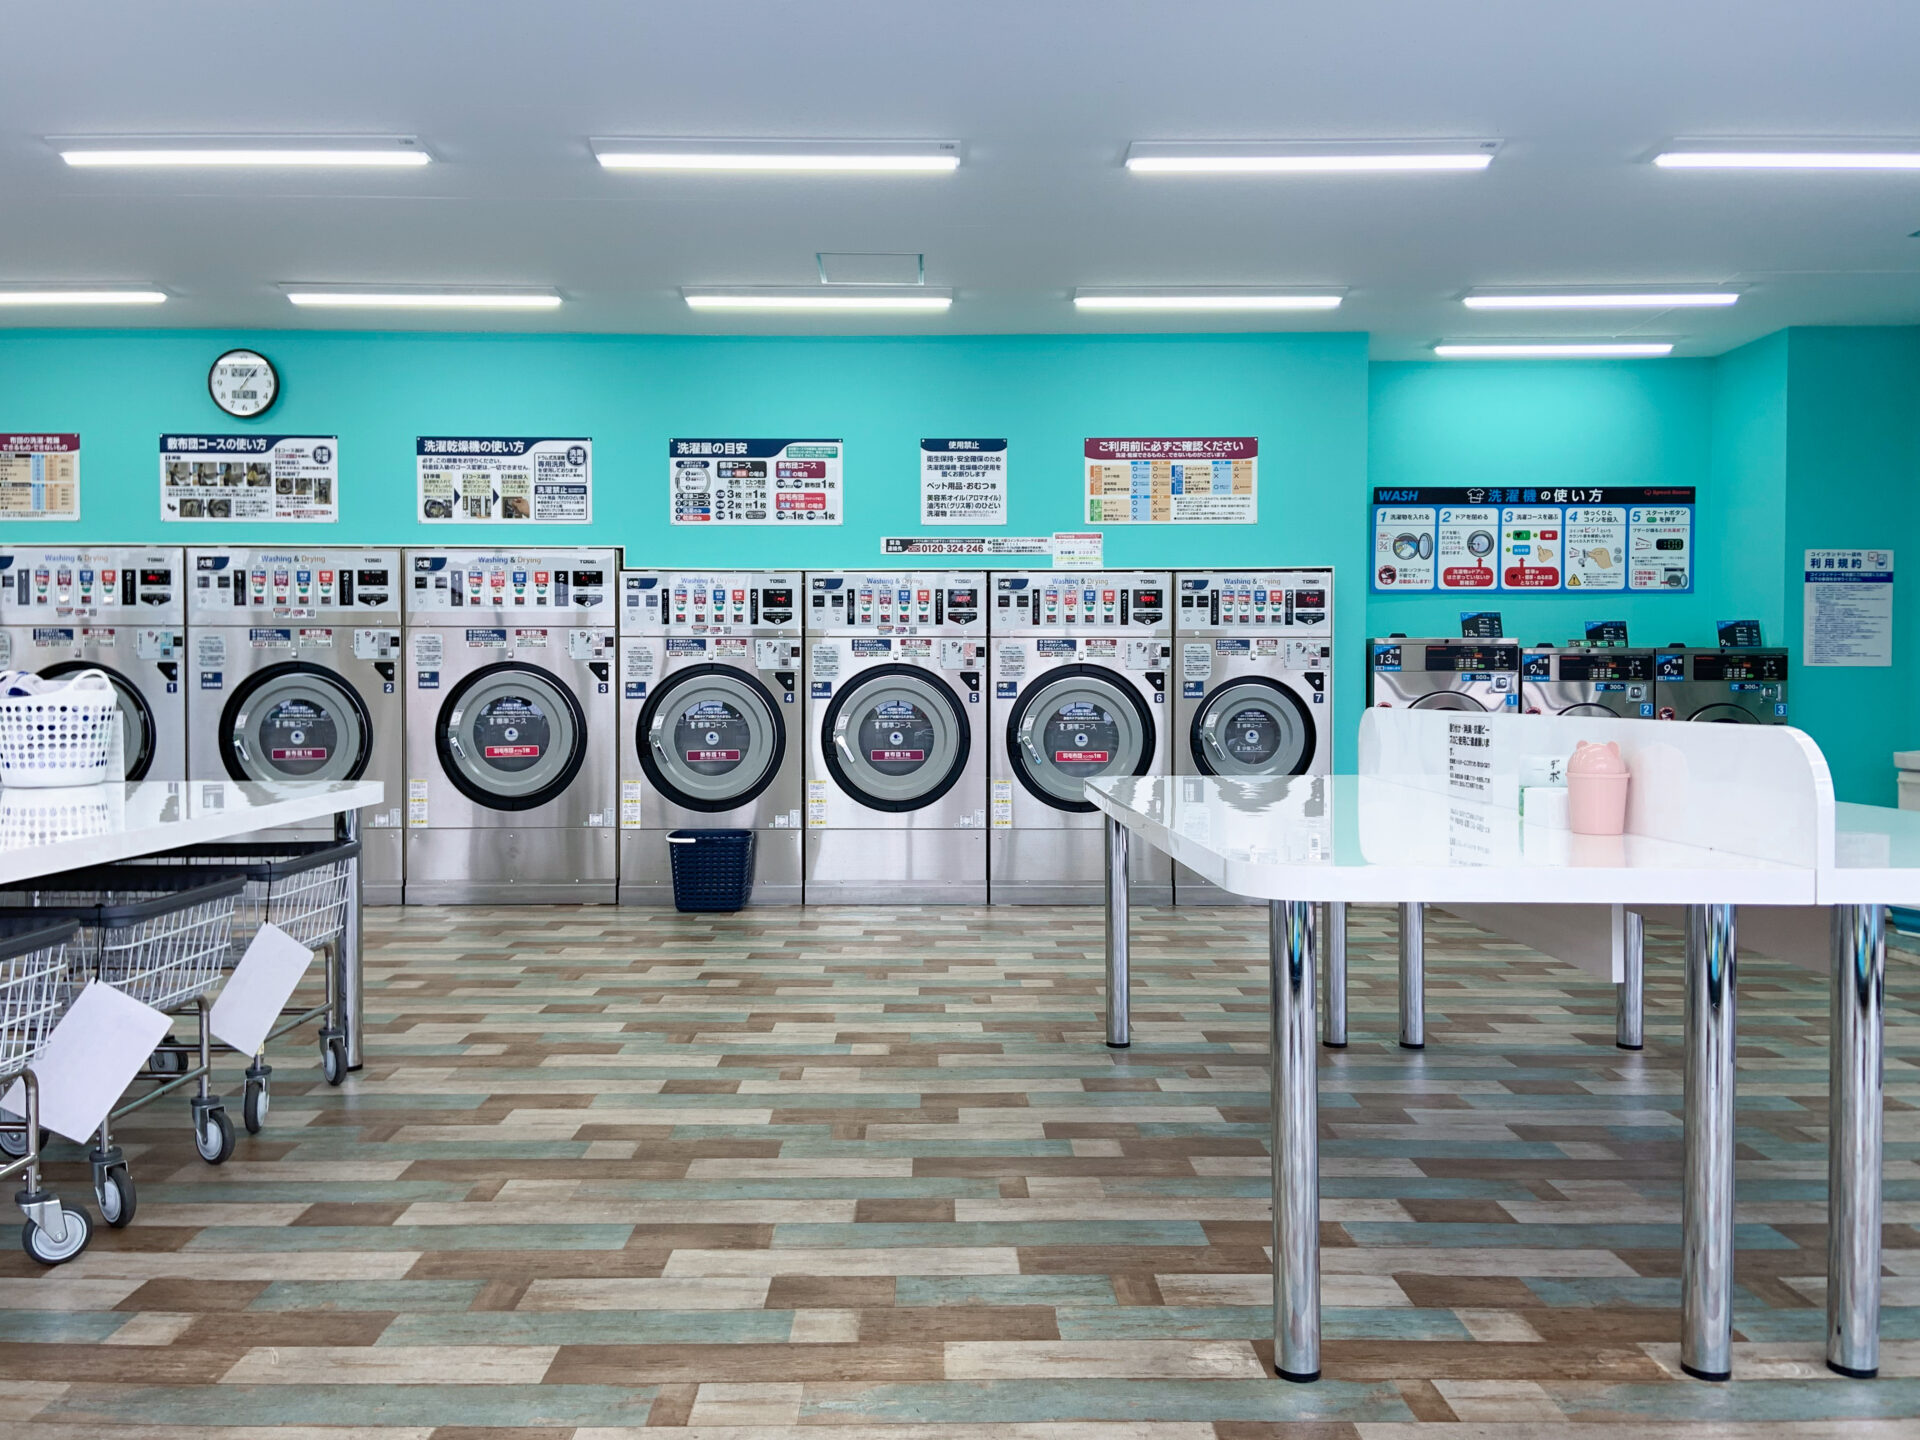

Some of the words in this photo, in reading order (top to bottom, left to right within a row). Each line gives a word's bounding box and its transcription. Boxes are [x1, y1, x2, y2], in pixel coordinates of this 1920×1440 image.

[167, 438, 267, 451] 敷布団コースの使い方
[424, 440, 524, 453] 洗濯乾燥機の使い方
[677, 442, 747, 454] 洗濯量の目安
[948, 441, 979, 450] 使用禁止
[1099, 441, 1243, 451] ご利用前に必ずご確認ください
[1379, 491, 1418, 501] WASH
[1488, 489, 1602, 502] 洗濯機の使い方
[1380, 512, 1386, 522] 1
[1442, 511, 1451, 522] 2
[1504, 511, 1513, 522] 3
[1569, 512, 1578, 522] 4
[1632, 511, 1641, 522] 5
[45, 554, 75, 562] Washing
[85, 554, 108, 562] Drying
[417, 560, 430, 568] 大型
[1811, 558, 1862, 569] 利用規約
[1380, 654, 1398, 665] 13kg
[1530, 664, 1543, 674] 9kg
[1664, 665, 1677, 674] 9kg
[386, 684, 392, 692] 2
